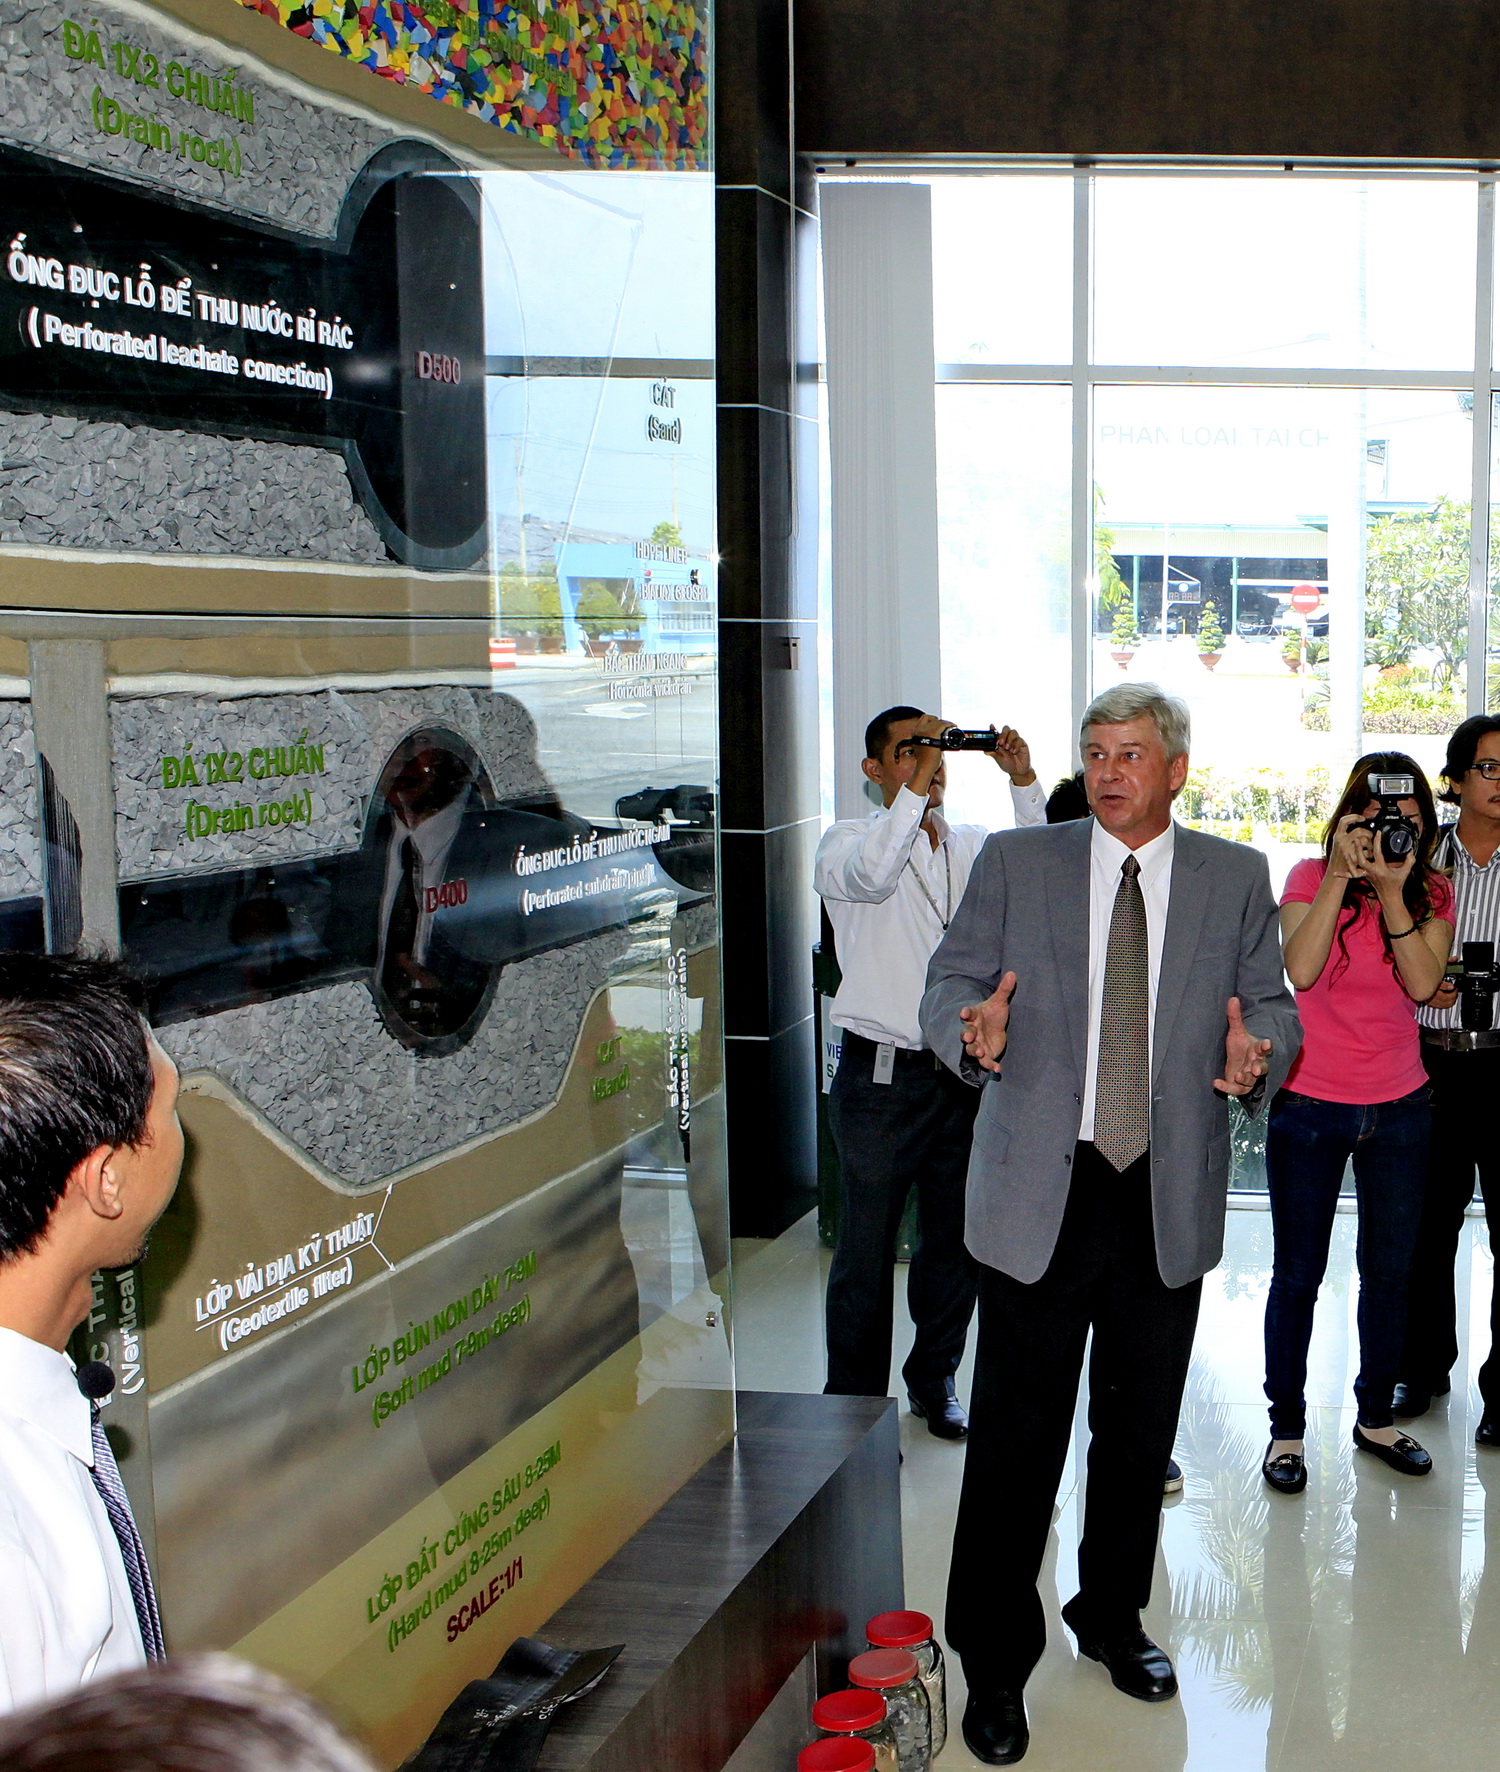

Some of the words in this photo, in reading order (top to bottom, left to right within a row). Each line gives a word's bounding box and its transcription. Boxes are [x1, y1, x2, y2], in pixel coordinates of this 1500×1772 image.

[62, 18, 107, 70] ĐÁ
[111, 41, 160, 90] 1X2
[91, 85, 172, 154] (Drain
[179, 131, 241, 178] rock)
[8, 232, 65, 290] ỐNG
[68, 264, 120, 308] ĐỤC
[123, 262, 156, 309] LỖ
[160, 277, 192, 317] ĐỂ
[196, 294, 239, 326] THU
[240, 300, 294, 338] NƯỚC
[296, 307, 316, 343] RỈ
[317, 316, 354, 350] RÁC
[160, 336, 239, 376] leachate
[243, 358, 333, 400] conection)
[418, 350, 461, 385] D500
[648, 413, 682, 445] (Sand)
[162, 743, 200, 789] ĐÁ
[202, 752, 244, 785] 1X2
[248, 727, 325, 779] CHUẨN
[185, 800, 254, 842] (Drain
[258, 788, 313, 827] rock)
[597, 835, 617, 858] THU
[425, 878, 468, 914] D400
[522, 880, 584, 916] (Perforated
[196, 1278, 233, 1322] LỚP
[236, 1262, 265, 1300] VẢI
[266, 1253, 297, 1286] ĐỊA
[298, 1232, 323, 1271] KỸ
[325, 1212, 375, 1255] THUẬT
[219, 1286, 310, 1351] (Geotextile
[313, 1256, 353, 1299] filter)
[115, 1269, 146, 1395] (Vertical
[353, 1344, 391, 1394] LỚP
[393, 1321, 431, 1367] BÙN
[433, 1296, 469, 1341] NON
[471, 1273, 499, 1315] DÀY
[503, 1250, 537, 1292] 7-9M
[372, 1375, 415, 1429] (Soft
[417, 1348, 453, 1393] mud
[455, 1327, 491, 1365] 7-9m
[492, 1293, 532, 1339] deep)
[366, 1573, 403, 1625] LỚP
[405, 1536, 440, 1591] ĐẤT
[444, 1501, 490, 1557] CỨNG
[524, 1440, 562, 1489] 8-25M
[388, 1590, 433, 1653] (Hard
[434, 1560, 468, 1610] mud
[469, 1526, 513, 1576] 8-25m
[514, 1487, 551, 1536] deep)
[447, 1556, 523, 1643] SCALE:1/1
